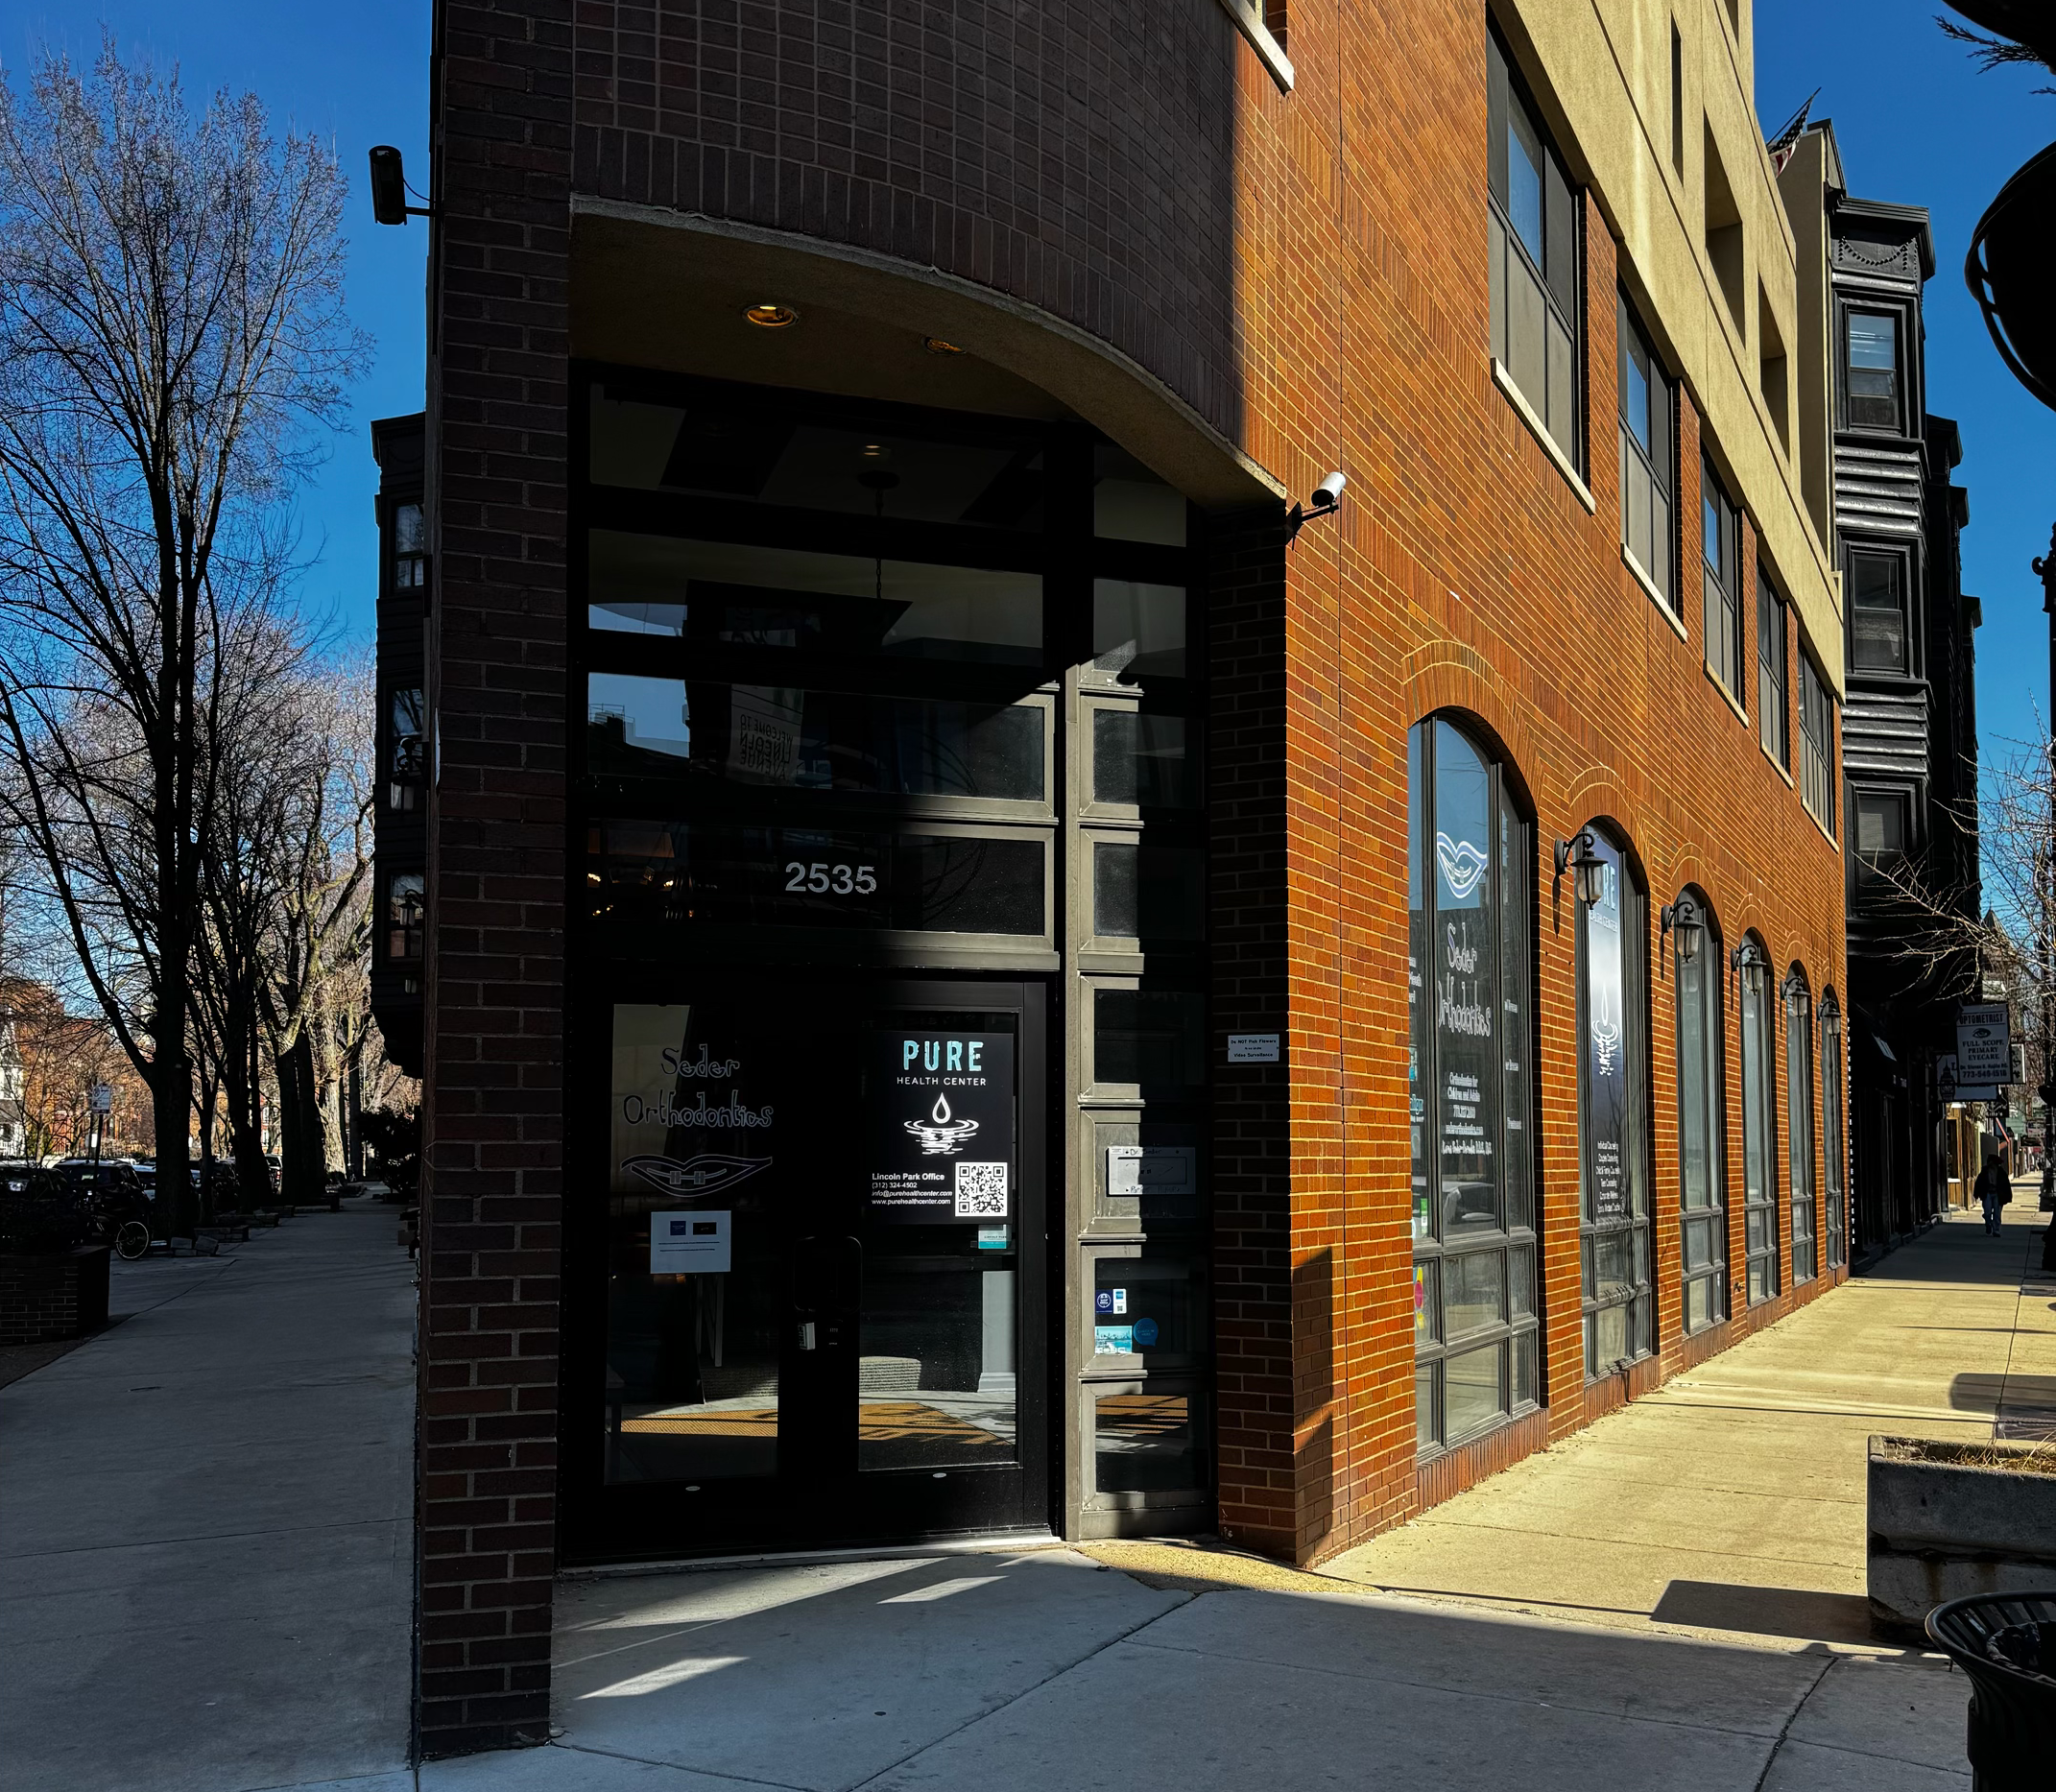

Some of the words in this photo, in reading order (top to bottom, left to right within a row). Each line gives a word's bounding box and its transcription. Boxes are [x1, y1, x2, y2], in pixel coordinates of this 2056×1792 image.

[785, 862, 876, 895] 2535
[1447, 922, 1478, 974] Seder
[1959, 1014, 2003, 1025] OPTOMETRIST
[661, 1043, 740, 1078] Seder
[903, 1040, 984, 1072] PURE
[897, 1077, 939, 1086] HEALTH
[944, 1077, 987, 1086] CENTER
[624, 1089, 774, 1128] Orthodontics
